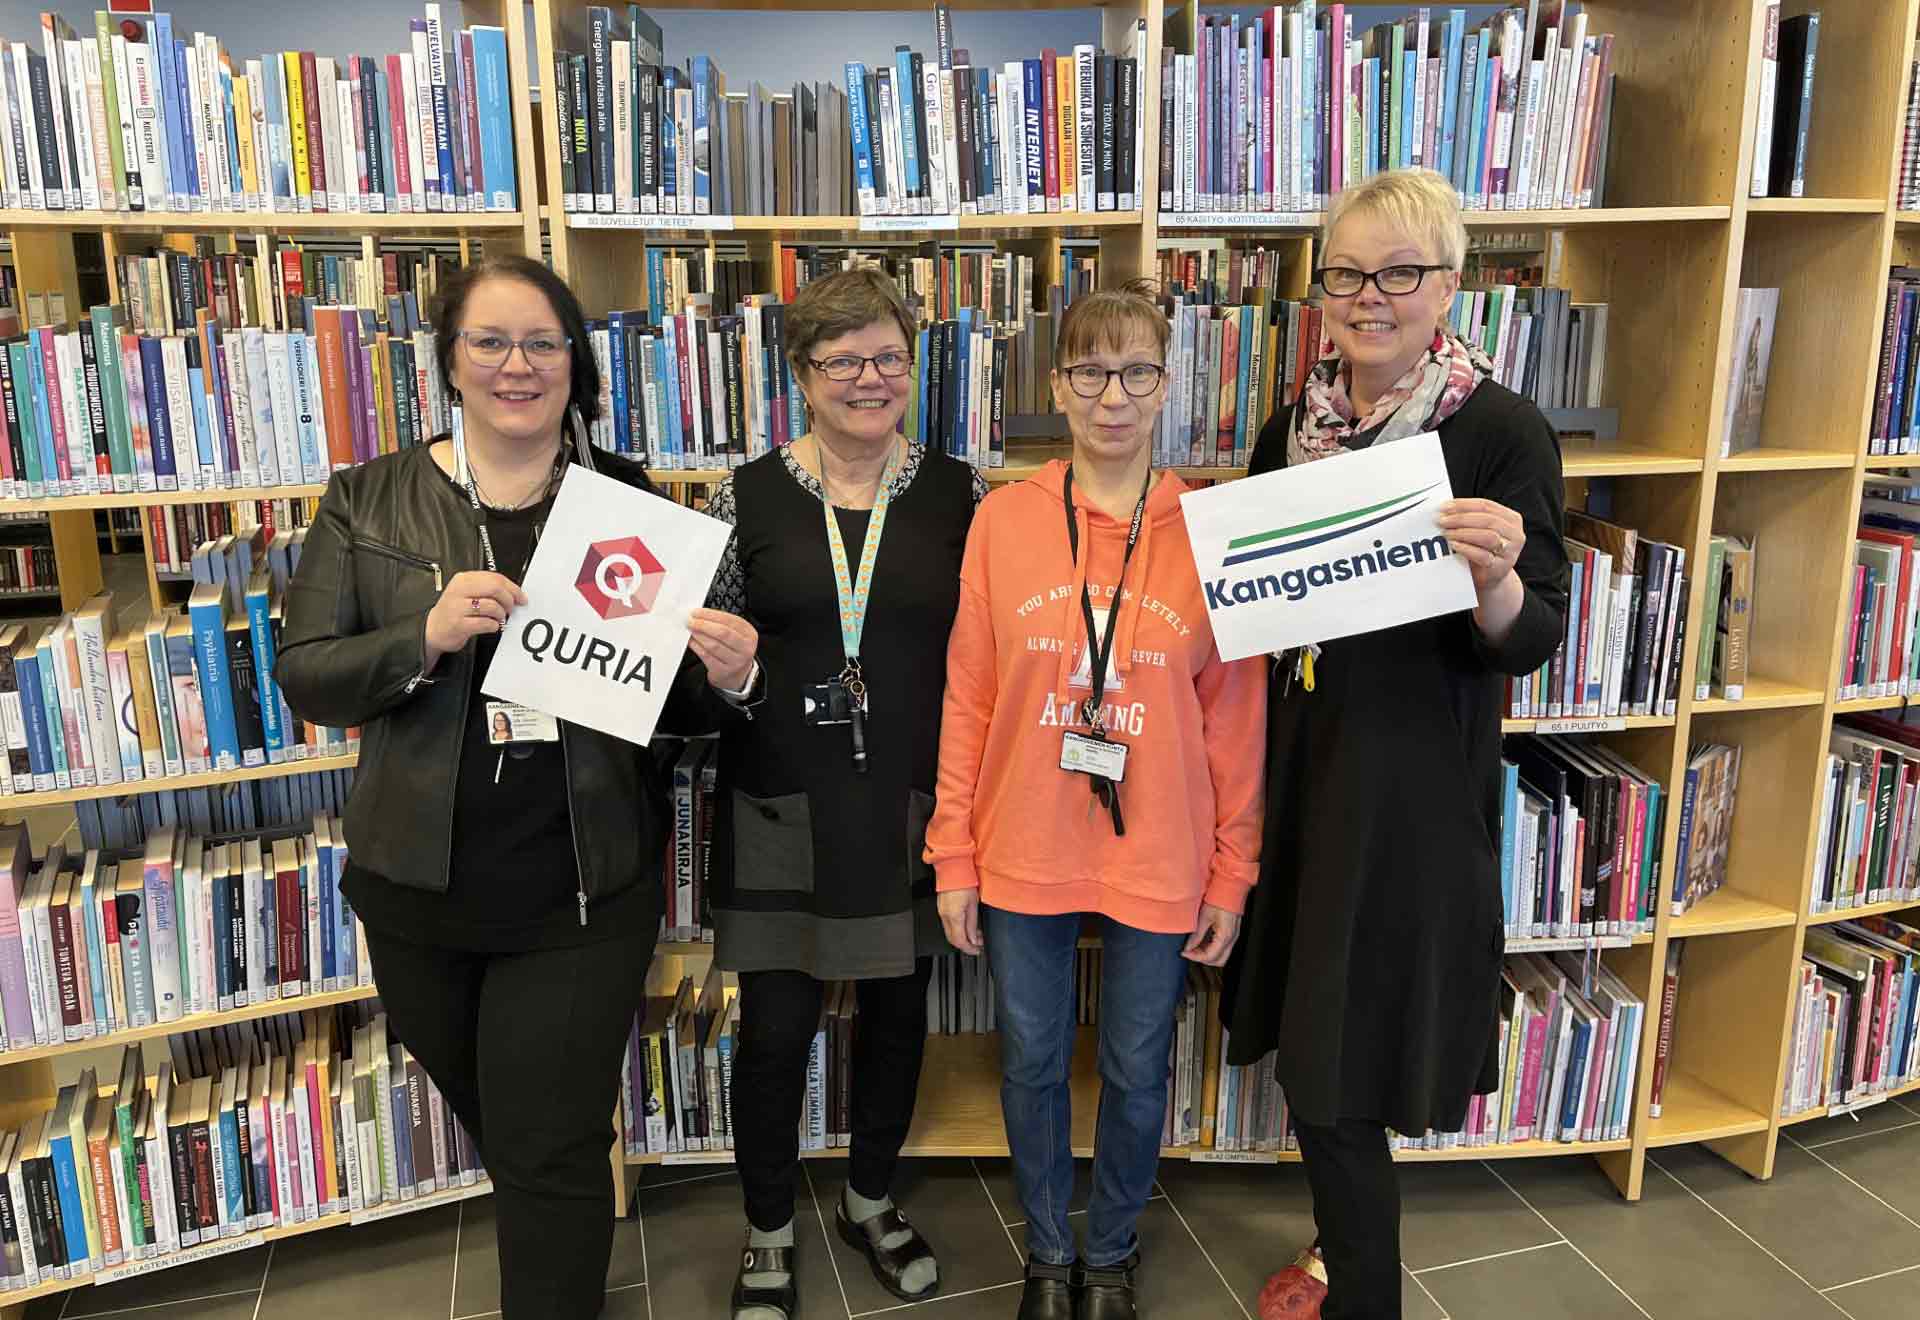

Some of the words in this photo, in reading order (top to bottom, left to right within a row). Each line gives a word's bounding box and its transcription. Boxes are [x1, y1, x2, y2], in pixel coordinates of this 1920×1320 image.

[429, 19, 442, 83] NIVELVAIVAT
[593, 20, 604, 67] Energiaa
[595, 67, 605, 109] tarvitaan
[926, 72, 939, 119] Google
[433, 87, 449, 151] HALLINTAAN
[574, 119, 587, 154] NOKIA
[1026, 107, 1041, 187] INTERNET
[416, 368, 429, 410] Reuma
[993, 388, 1002, 421] VERKKO
[301, 413, 312, 424] 8
[1204, 535, 1457, 610] Kangasniem
[1016, 594, 1044, 618] YOU
[202, 628, 220, 683] Psykiatria
[520, 618, 653, 693] QURIA
[1026, 635, 1066, 654] ALWAY
[677, 797, 691, 889] JUNAKIRJA
[410, 1075, 422, 1128] VAUVAKIRJA
